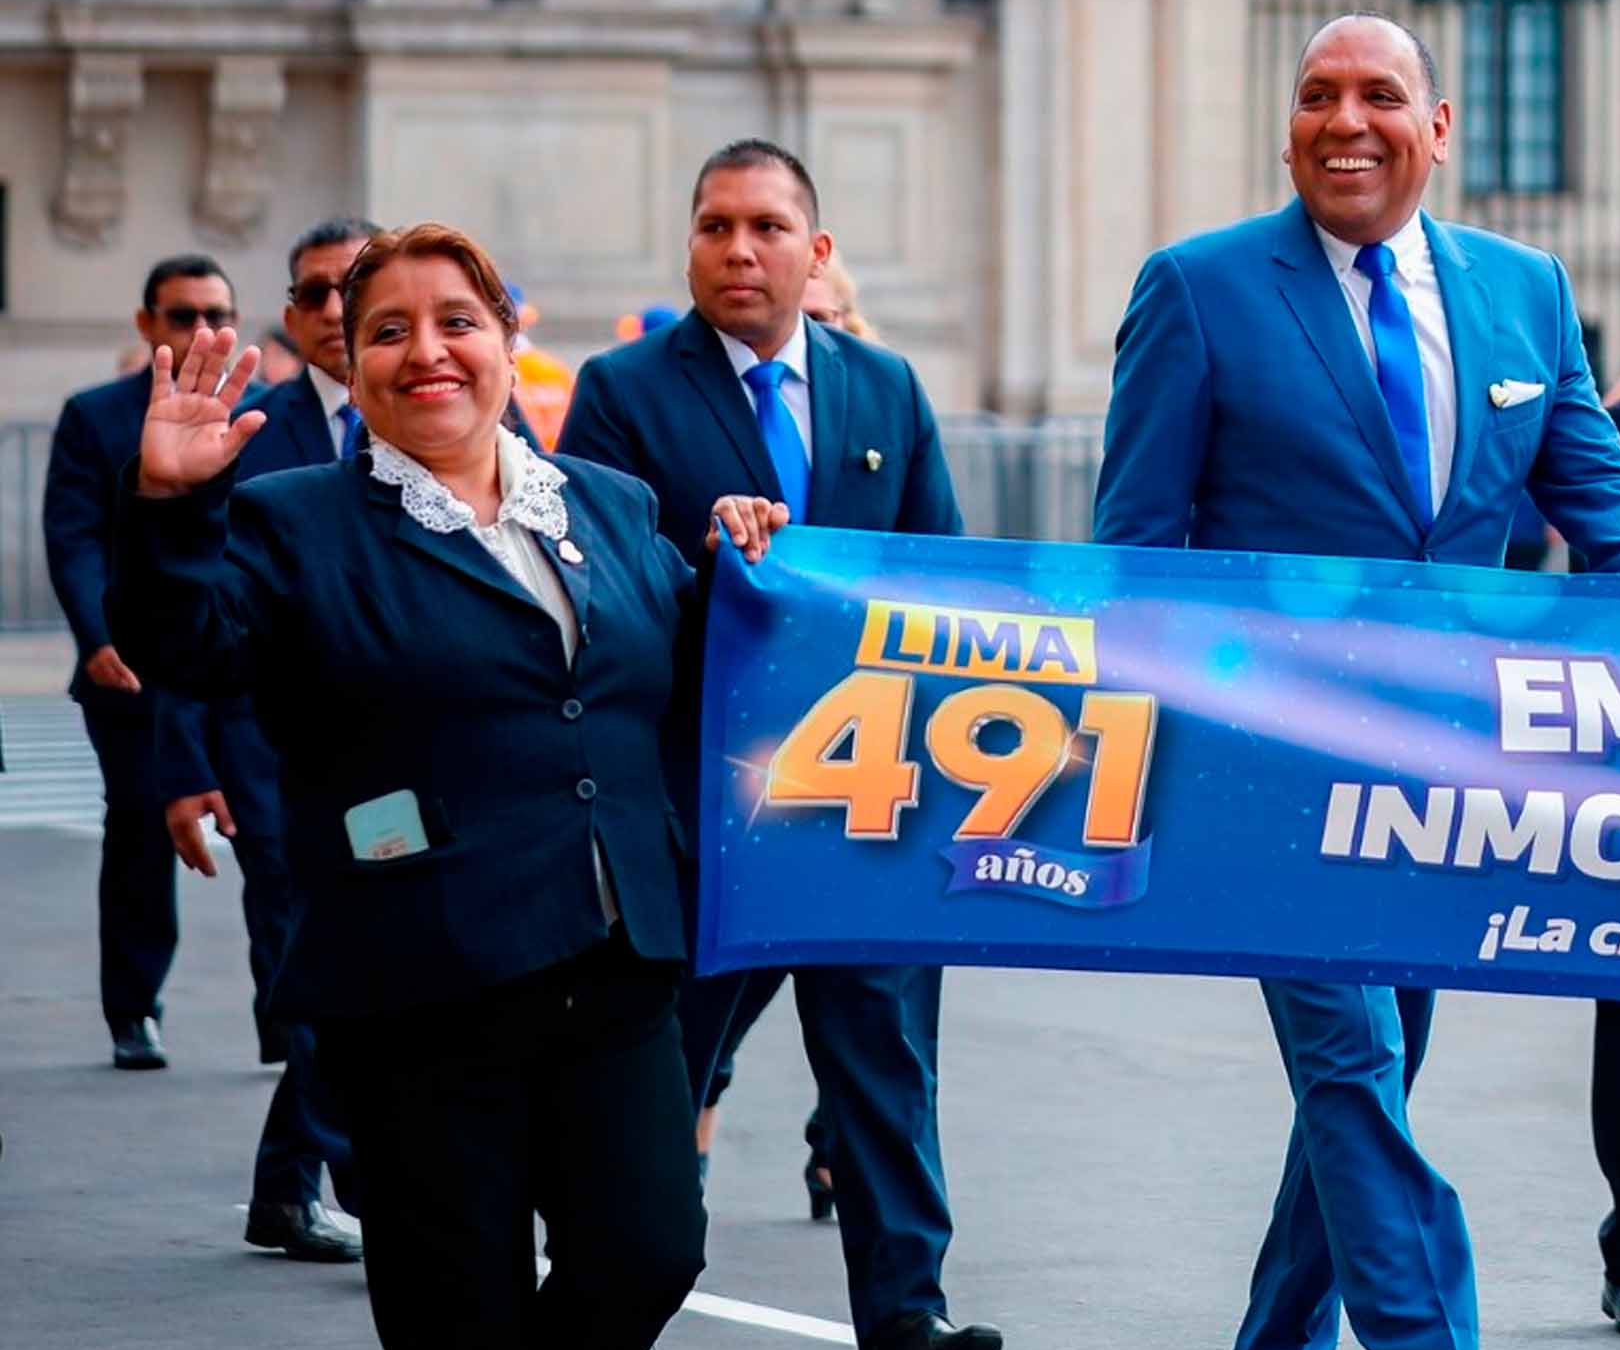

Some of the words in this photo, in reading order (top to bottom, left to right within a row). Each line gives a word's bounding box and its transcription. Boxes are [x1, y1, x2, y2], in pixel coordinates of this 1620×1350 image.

[880, 611, 1081, 673] LIMA
[766, 672, 1158, 847] 491
[974, 848, 1091, 898] años
[1478, 904, 1576, 961] ¡La
